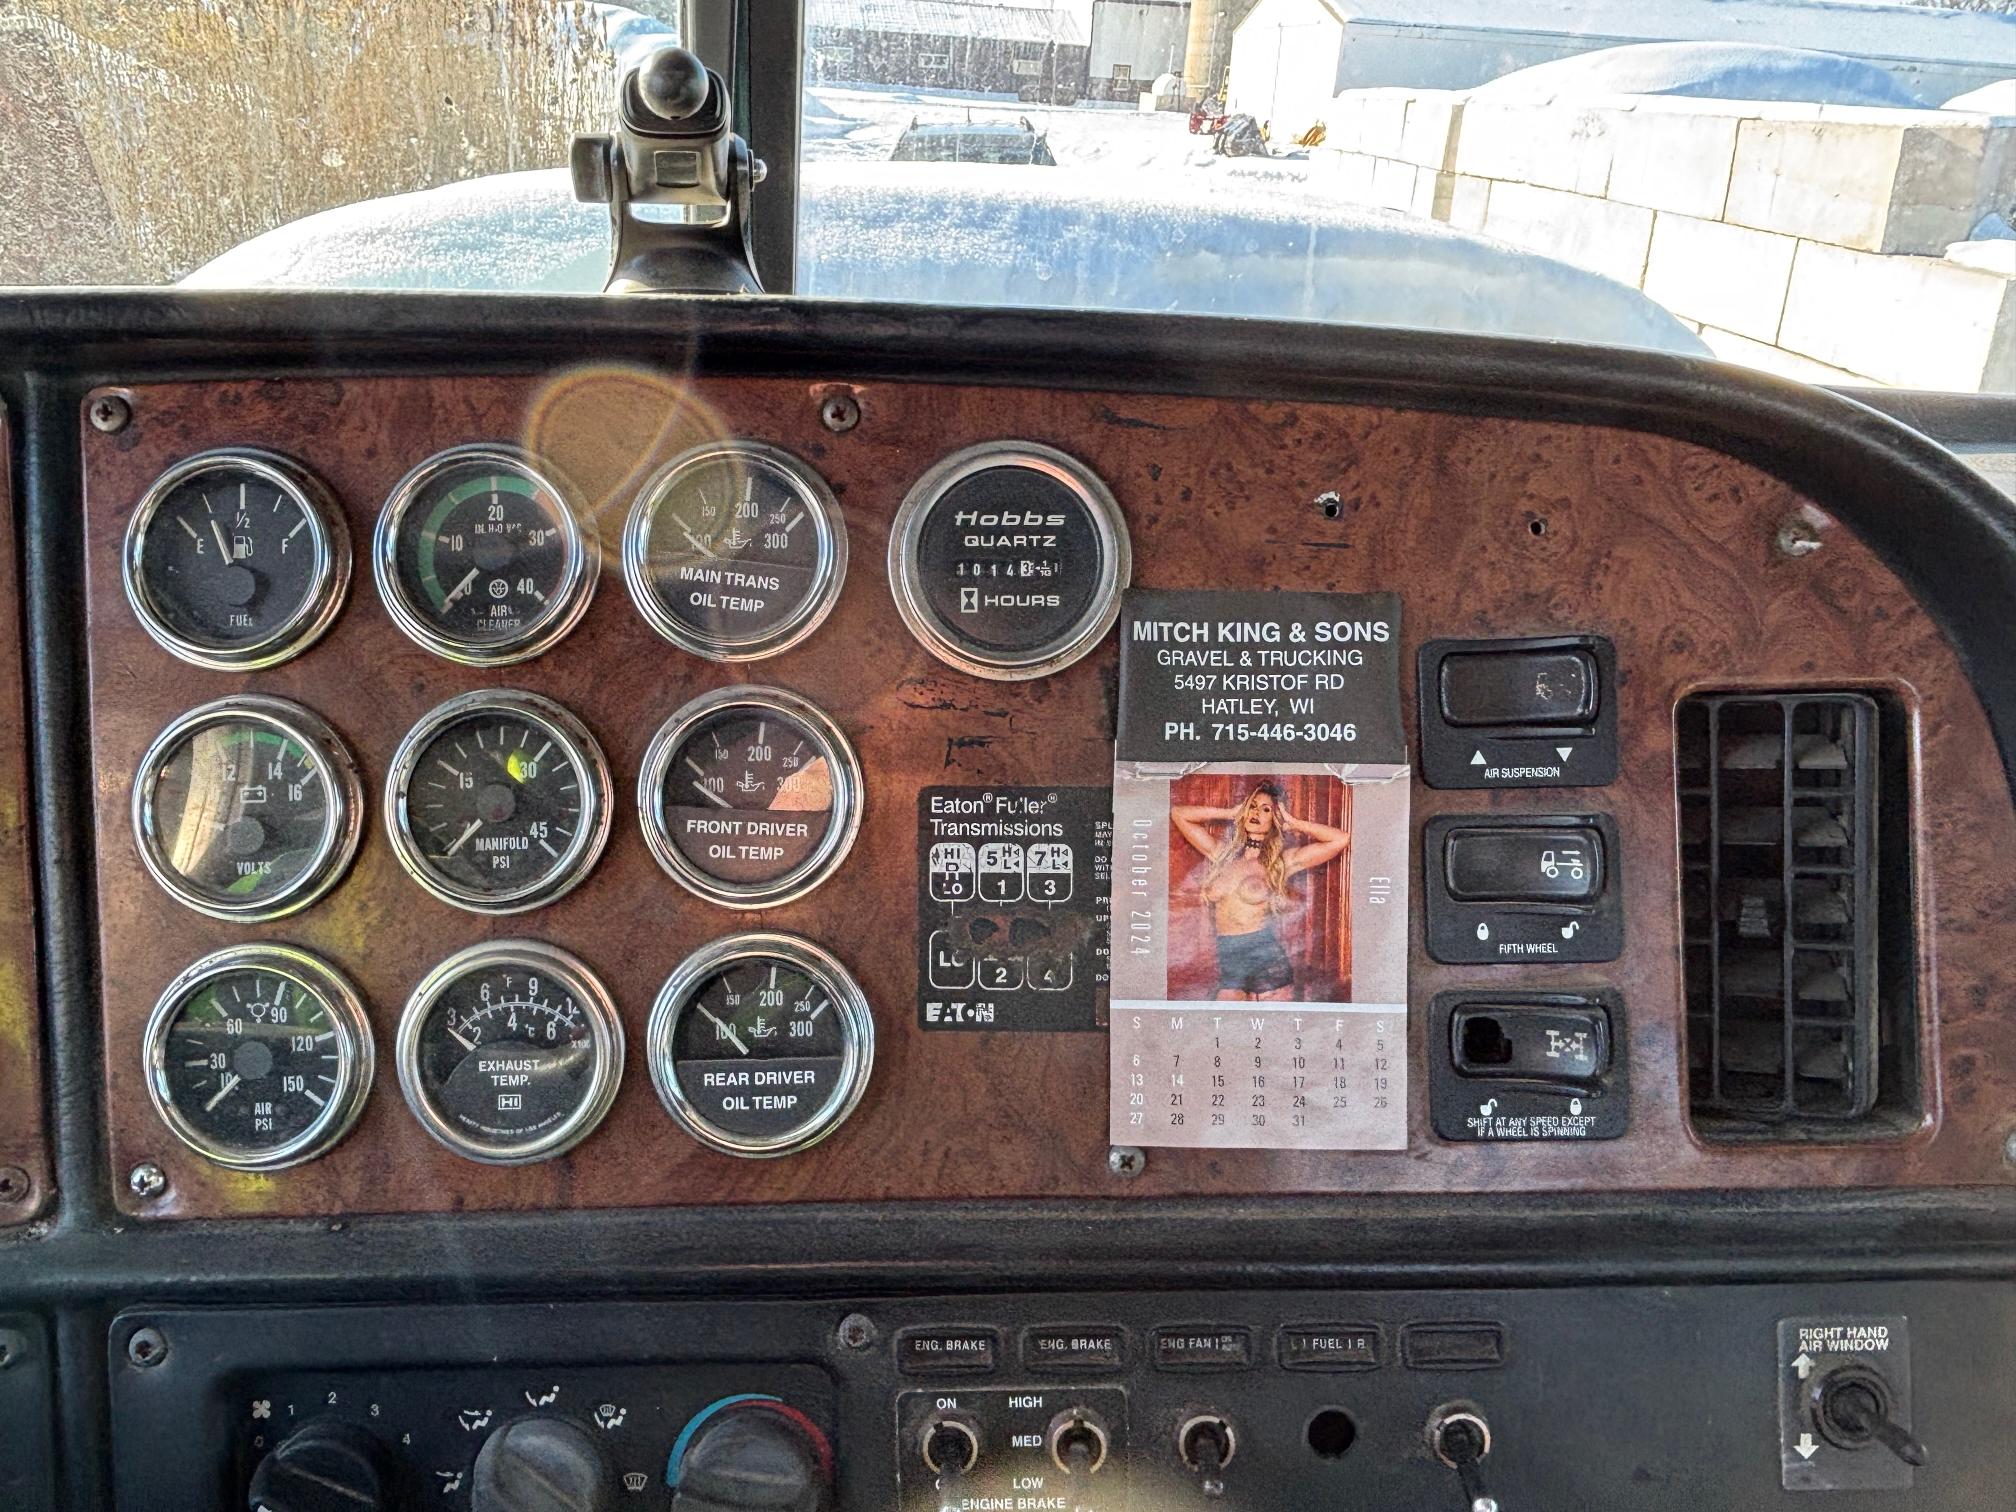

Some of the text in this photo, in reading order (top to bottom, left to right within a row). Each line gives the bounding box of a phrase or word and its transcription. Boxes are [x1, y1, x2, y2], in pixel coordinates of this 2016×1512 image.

[488, 505, 504, 521] 20
[702, 506, 716, 516] 150
[735, 502, 758, 518] 200
[770, 514, 785, 524] 250
[954, 510, 1066, 526] Hobbs
[451, 535, 463, 551] 10
[528, 530, 544, 546] 30
[764, 533, 788, 549] 300
[964, 535, 1057, 547] QUARTZ
[196, 538, 204, 554] E
[282, 540, 289, 554] F
[517, 578, 533, 594] 40
[680, 567, 780, 591] MAIN TRANS
[689, 592, 764, 612] OIL TEMP
[984, 595, 1060, 607] HOURS
[491, 605, 508, 617] AIR
[1133, 620, 1390, 643] MITCH KING & SONS
[1157, 649, 1363, 667] GRAVEL & TRUCKING
[1174, 674, 1345, 691] 5497 KRISTOF RD
[1202, 698, 1314, 717] HATLEY, WI
[1164, 722, 1357, 742] PH. 715-446-3046
[715, 749, 729, 760] 150
[747, 746, 771, 762] 200
[520, 762, 537, 778] 30
[782, 757, 799, 768] 250
[223, 764, 236, 781] 12
[268, 762, 283, 780] 14
[1484, 767, 1560, 779] AIR SUSPENSION
[459, 772, 474, 790] 15
[702, 777, 724, 794] 100
[288, 784, 302, 802] 16
[529, 822, 548, 838] 45
[687, 819, 808, 838] FRONT DRIVER
[929, 819, 1063, 837] Transmissions
[475, 836, 529, 851] MANIFOLD
[708, 844, 785, 861] OIL TEMP
[944, 848, 960, 859] HI
[986, 851, 998, 866] 5
[1034, 851, 1046, 866] 7
[237, 861, 272, 875] VOLTS
[492, 855, 510, 869] PSI
[997, 880, 1006, 895] 1
[1044, 880, 1056, 895] 3
[1130, 820, 1152, 954] October 2024
[1369, 877, 1390, 904] Ella
[1499, 943, 1558, 954] FIFTH WHEEL
[995, 967, 1007, 983] 2
[481, 983, 490, 1001] 6
[529, 977, 538, 996] 9
[726, 994, 740, 1005] 150
[759, 991, 783, 1006] 200
[794, 1001, 811, 1013] 250
[270, 1007, 287, 1024] 90
[447, 1008, 456, 1026] 3
[508, 1012, 517, 1031] 4
[226, 1018, 243, 1035] 60
[789, 1021, 812, 1037] 300
[1336, 1020, 1384, 1033] F S
[472, 1027, 481, 1044] 2
[291, 1035, 313, 1052] 120
[1215, 1037, 1383, 1051] 1 2 3 4 5
[210, 1053, 226, 1070] 30
[478, 1060, 539, 1072] EXHAUST
[1133, 1055, 1387, 1070] 6 7 8 9 10 11 12
[283, 1076, 304, 1092] 150
[491, 1075, 531, 1086] TEMP.
[704, 1071, 815, 1087] REAR DRIVER
[1130, 1073, 1387, 1090] 13 14 15 16 17 18 19
[722, 1095, 797, 1110] OIL TEMP
[1130, 1093, 1388, 1108] 20 21 22 23 24 25 26
[254, 1102, 273, 1115] AIR
[255, 1118, 273, 1131] PSI
[1130, 1113, 1305, 1126] 27 28 29 30 31
[1467, 1117, 1596, 1128] SHIFT AT ANY SPEED EXCEPT
[1478, 1126, 1586, 1137] IF A WHEEL IS SPINNING
[1799, 1326, 1888, 1340] RIGHT HAND
[915, 1340, 985, 1351] ENG. BRAKE
[1039, 1338, 1112, 1350] ENG. BRAKE
[1160, 1338, 1184, 1349] ENG
[1189, 1338, 1211, 1349] FAN
[1313, 1339, 1342, 1350] FUEL
[1799, 1338, 1889, 1353] AIR WINDOW
[328, 1392, 337, 1404] 2
[936, 1398, 956, 1409] ON
[1008, 1396, 1042, 1408] HIGH
[288, 1405, 294, 1416] 1
[370, 1404, 380, 1416] 3
[402, 1433, 411, 1445] 4
[1012, 1435, 1042, 1447] MED
[1013, 1478, 1043, 1489] LOW
[962, 1497, 1066, 1510] ENGINE BRAKE
